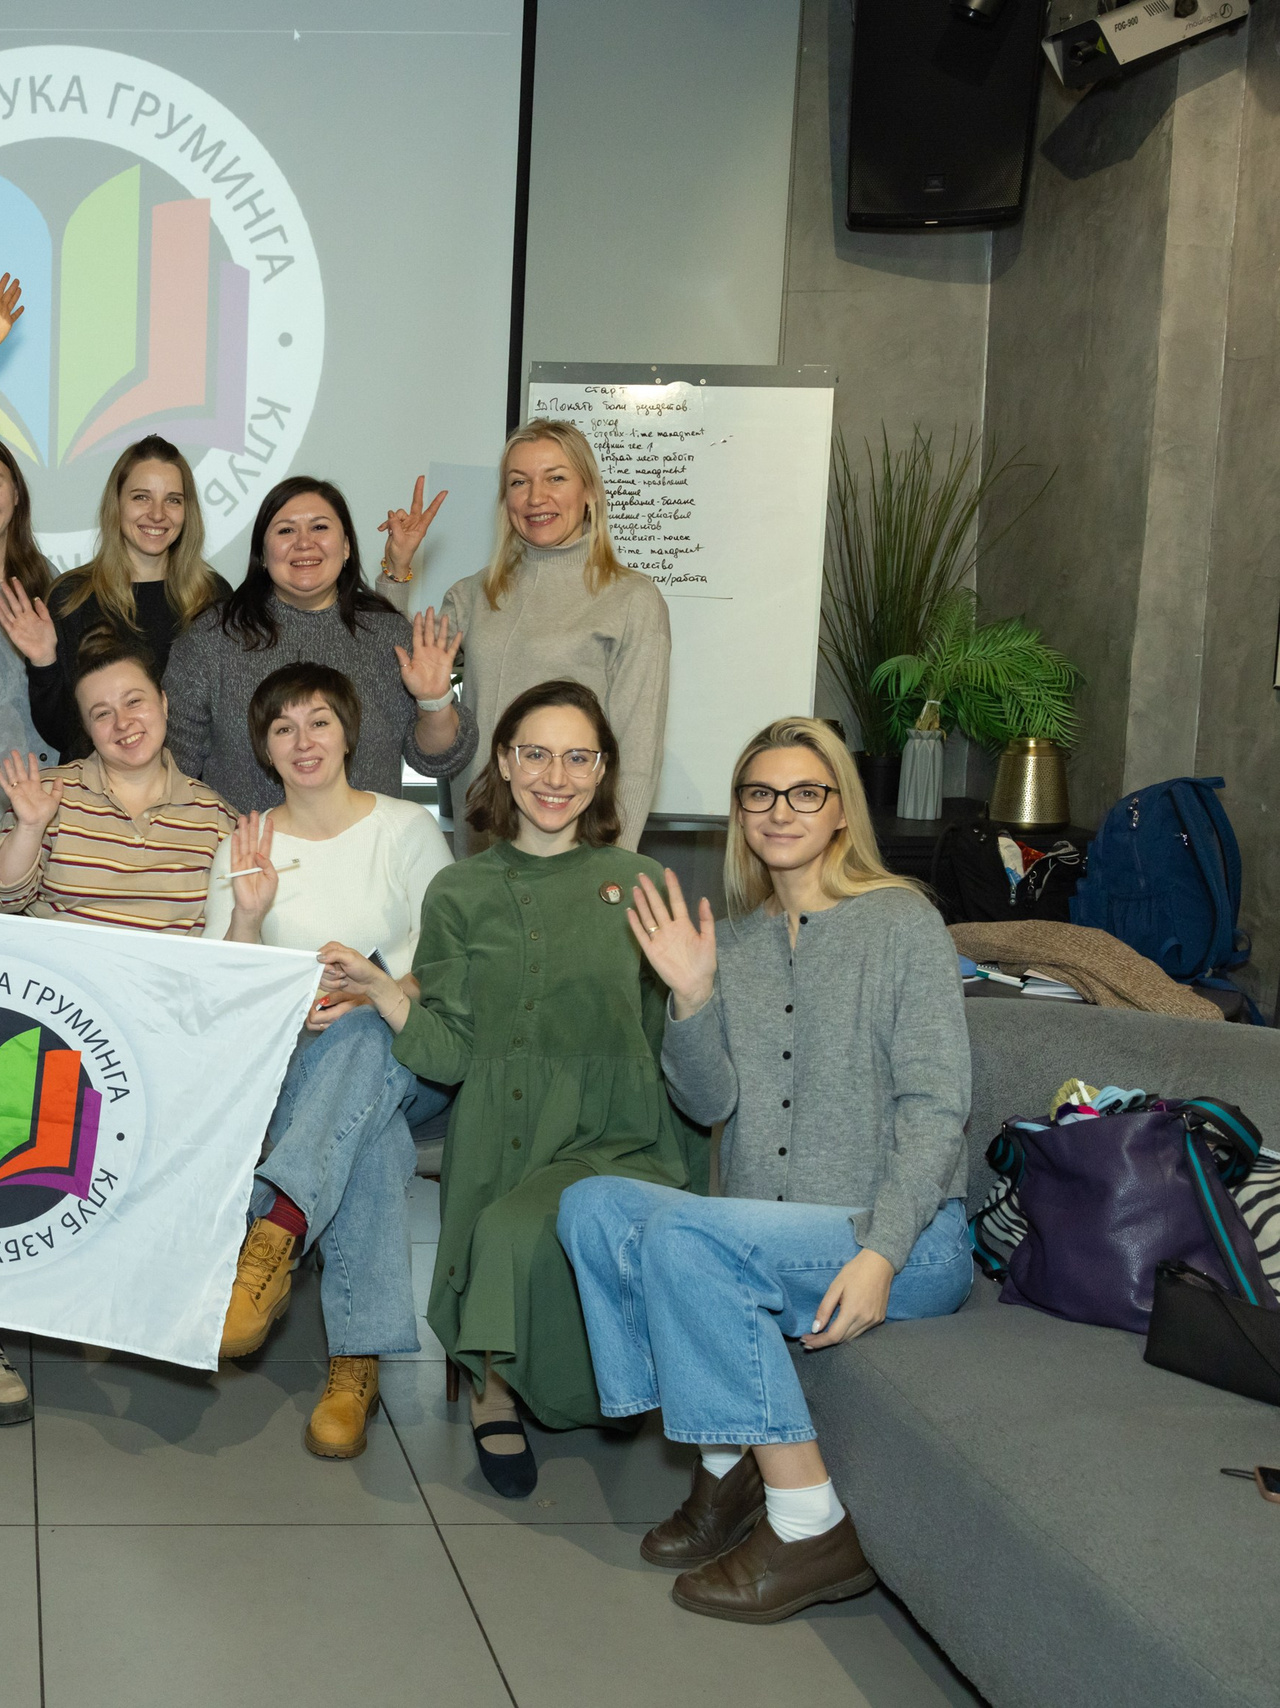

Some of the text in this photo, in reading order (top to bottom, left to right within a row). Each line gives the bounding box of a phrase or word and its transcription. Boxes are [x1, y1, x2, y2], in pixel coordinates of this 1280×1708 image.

[1114, 16, 1139, 33] FOG-900
[1184, 12, 1219, 31] showlight
[106, 82, 296, 284] ГРУМИНГА
[204, 396, 292, 518] КЛУБ
[662, 451, 694, 467] работы
[617, 545, 642, 555] time
[627, 559, 673, 570] качество
[22, 978, 131, 1104] ГРУМИНГА
[60, 1167, 119, 1236] КЛУБ
